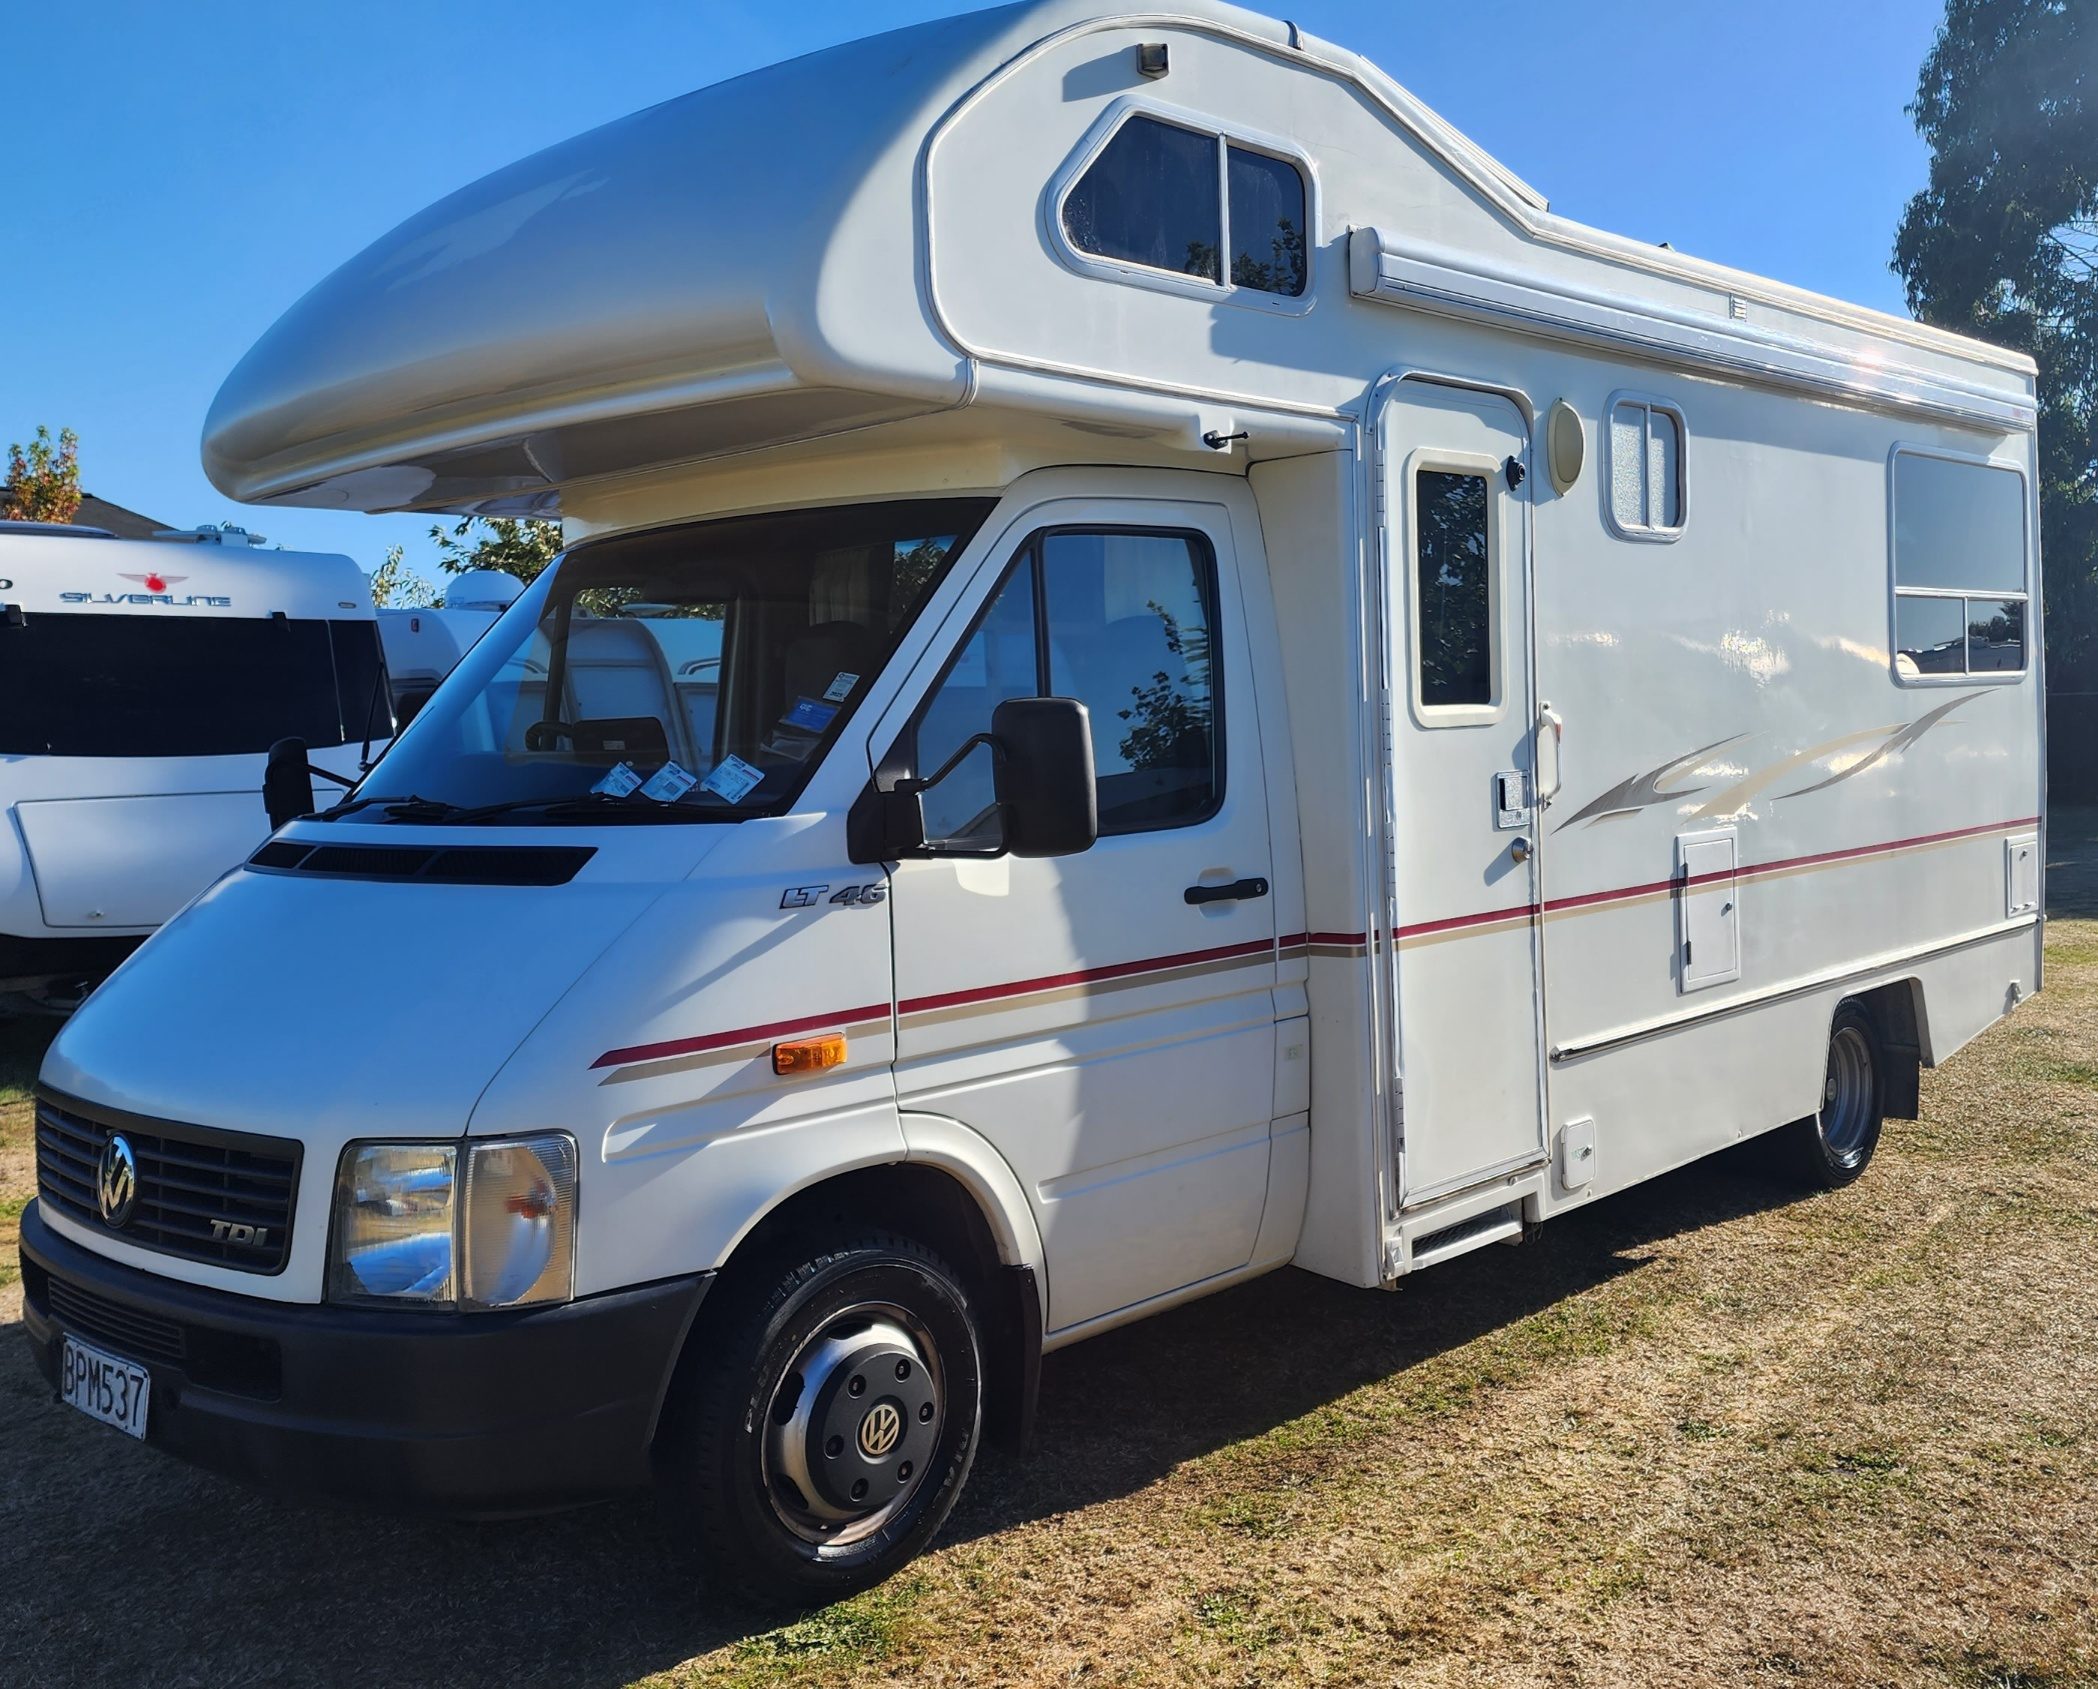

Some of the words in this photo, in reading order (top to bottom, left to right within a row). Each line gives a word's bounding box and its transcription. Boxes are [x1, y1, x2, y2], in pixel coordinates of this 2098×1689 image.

[59, 592, 232, 607] SILVERLINE
[779, 884, 829, 910] LT
[829, 884, 887, 906] 46
[210, 1219, 268, 1247] TDI
[64, 1342, 145, 1428] BPM537
